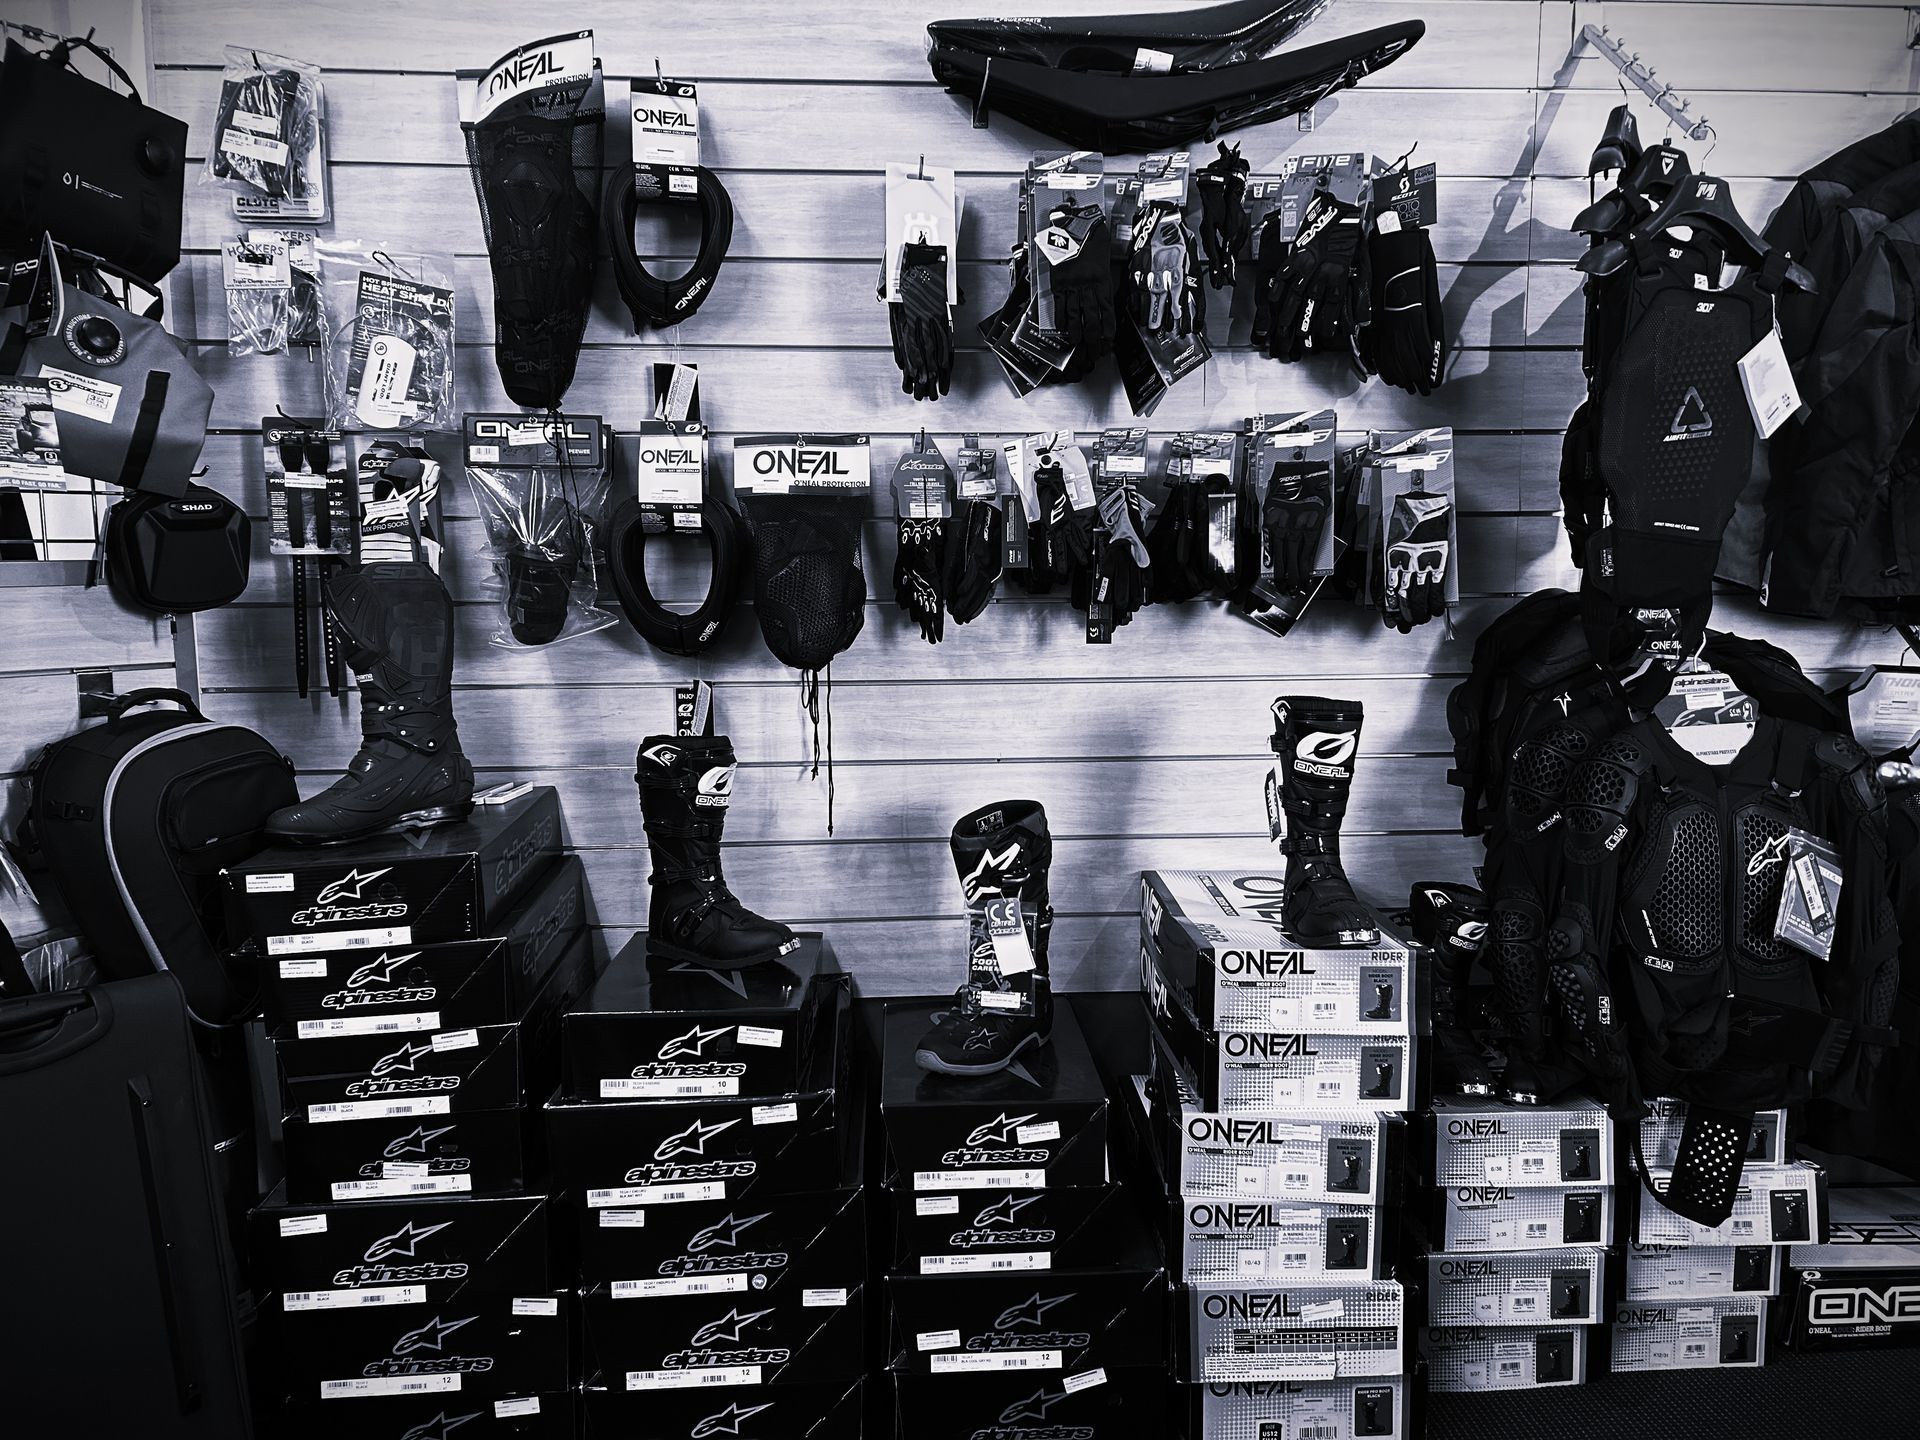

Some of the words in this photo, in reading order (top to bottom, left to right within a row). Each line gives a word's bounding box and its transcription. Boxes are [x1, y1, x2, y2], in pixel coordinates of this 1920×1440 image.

[545, 73, 589, 86] PROTECTION
[633, 108, 696, 128] O'NEAL
[236, 197, 278, 207] CLUTC
[1391, 190, 1419, 201] SCOTT
[1391, 199, 1420, 212] MOTO
[227, 243, 284, 256] HOOKERS
[361, 282, 397, 296] HEAT
[382, 280, 417, 292] SPRINGS
[675, 276, 711, 310] ONEAL
[1431, 340, 1440, 382] SCOTT
[1663, 433, 1687, 442] AIRFIT
[641, 449, 699, 466] O'NEAL
[753, 448, 849, 479] O'NEAL
[363, 525, 372, 533] MX
[373, 523, 387, 532] PRO
[388, 519, 410, 529] SOCKS
[1674, 677, 1729, 687] alpinestars
[1294, 760, 1350, 778] ONEAL
[292, 903, 407, 926] alpinestars
[990, 903, 1015, 921] CE
[1221, 949, 1317, 980] O'NEAL
[1371, 952, 1403, 961] RIDER
[322, 987, 436, 1009] alpinestars
[1225, 1034, 1319, 1061] O'NEAL
[631, 1061, 746, 1080] alpinestars
[346, 1076, 460, 1098] alpinestars
[1340, 1124, 1374, 1135] RIDER
[1448, 1119, 1508, 1137] O'NEAL
[1568, 1117, 1597, 1127] RIDER
[1188, 1117, 1284, 1148] O'NEAL
[942, 1148, 1049, 1167] alpinestars
[625, 1160, 756, 1185] alpinestars
[1457, 1186, 1515, 1203] O'NEAL
[1190, 1203, 1282, 1232] O'NEAL
[1338, 1205, 1372, 1213] RIDER
[950, 1228, 1055, 1248] alpinestars
[658, 1252, 788, 1277] alpinestars
[1439, 1259, 1499, 1277] O'NEAL
[333, 1262, 468, 1287] alpinestars
[1366, 1292, 1400, 1301] RIDER
[1203, 1292, 1301, 1323] O'NEAL
[1617, 1308, 1673, 1326] O'NEAL
[966, 1331, 1090, 1353] alpinestars
[1428, 1327, 1486, 1343] O'NEAL
[363, 1356, 493, 1377] alpinestars
[662, 1348, 790, 1369] alpinestars
